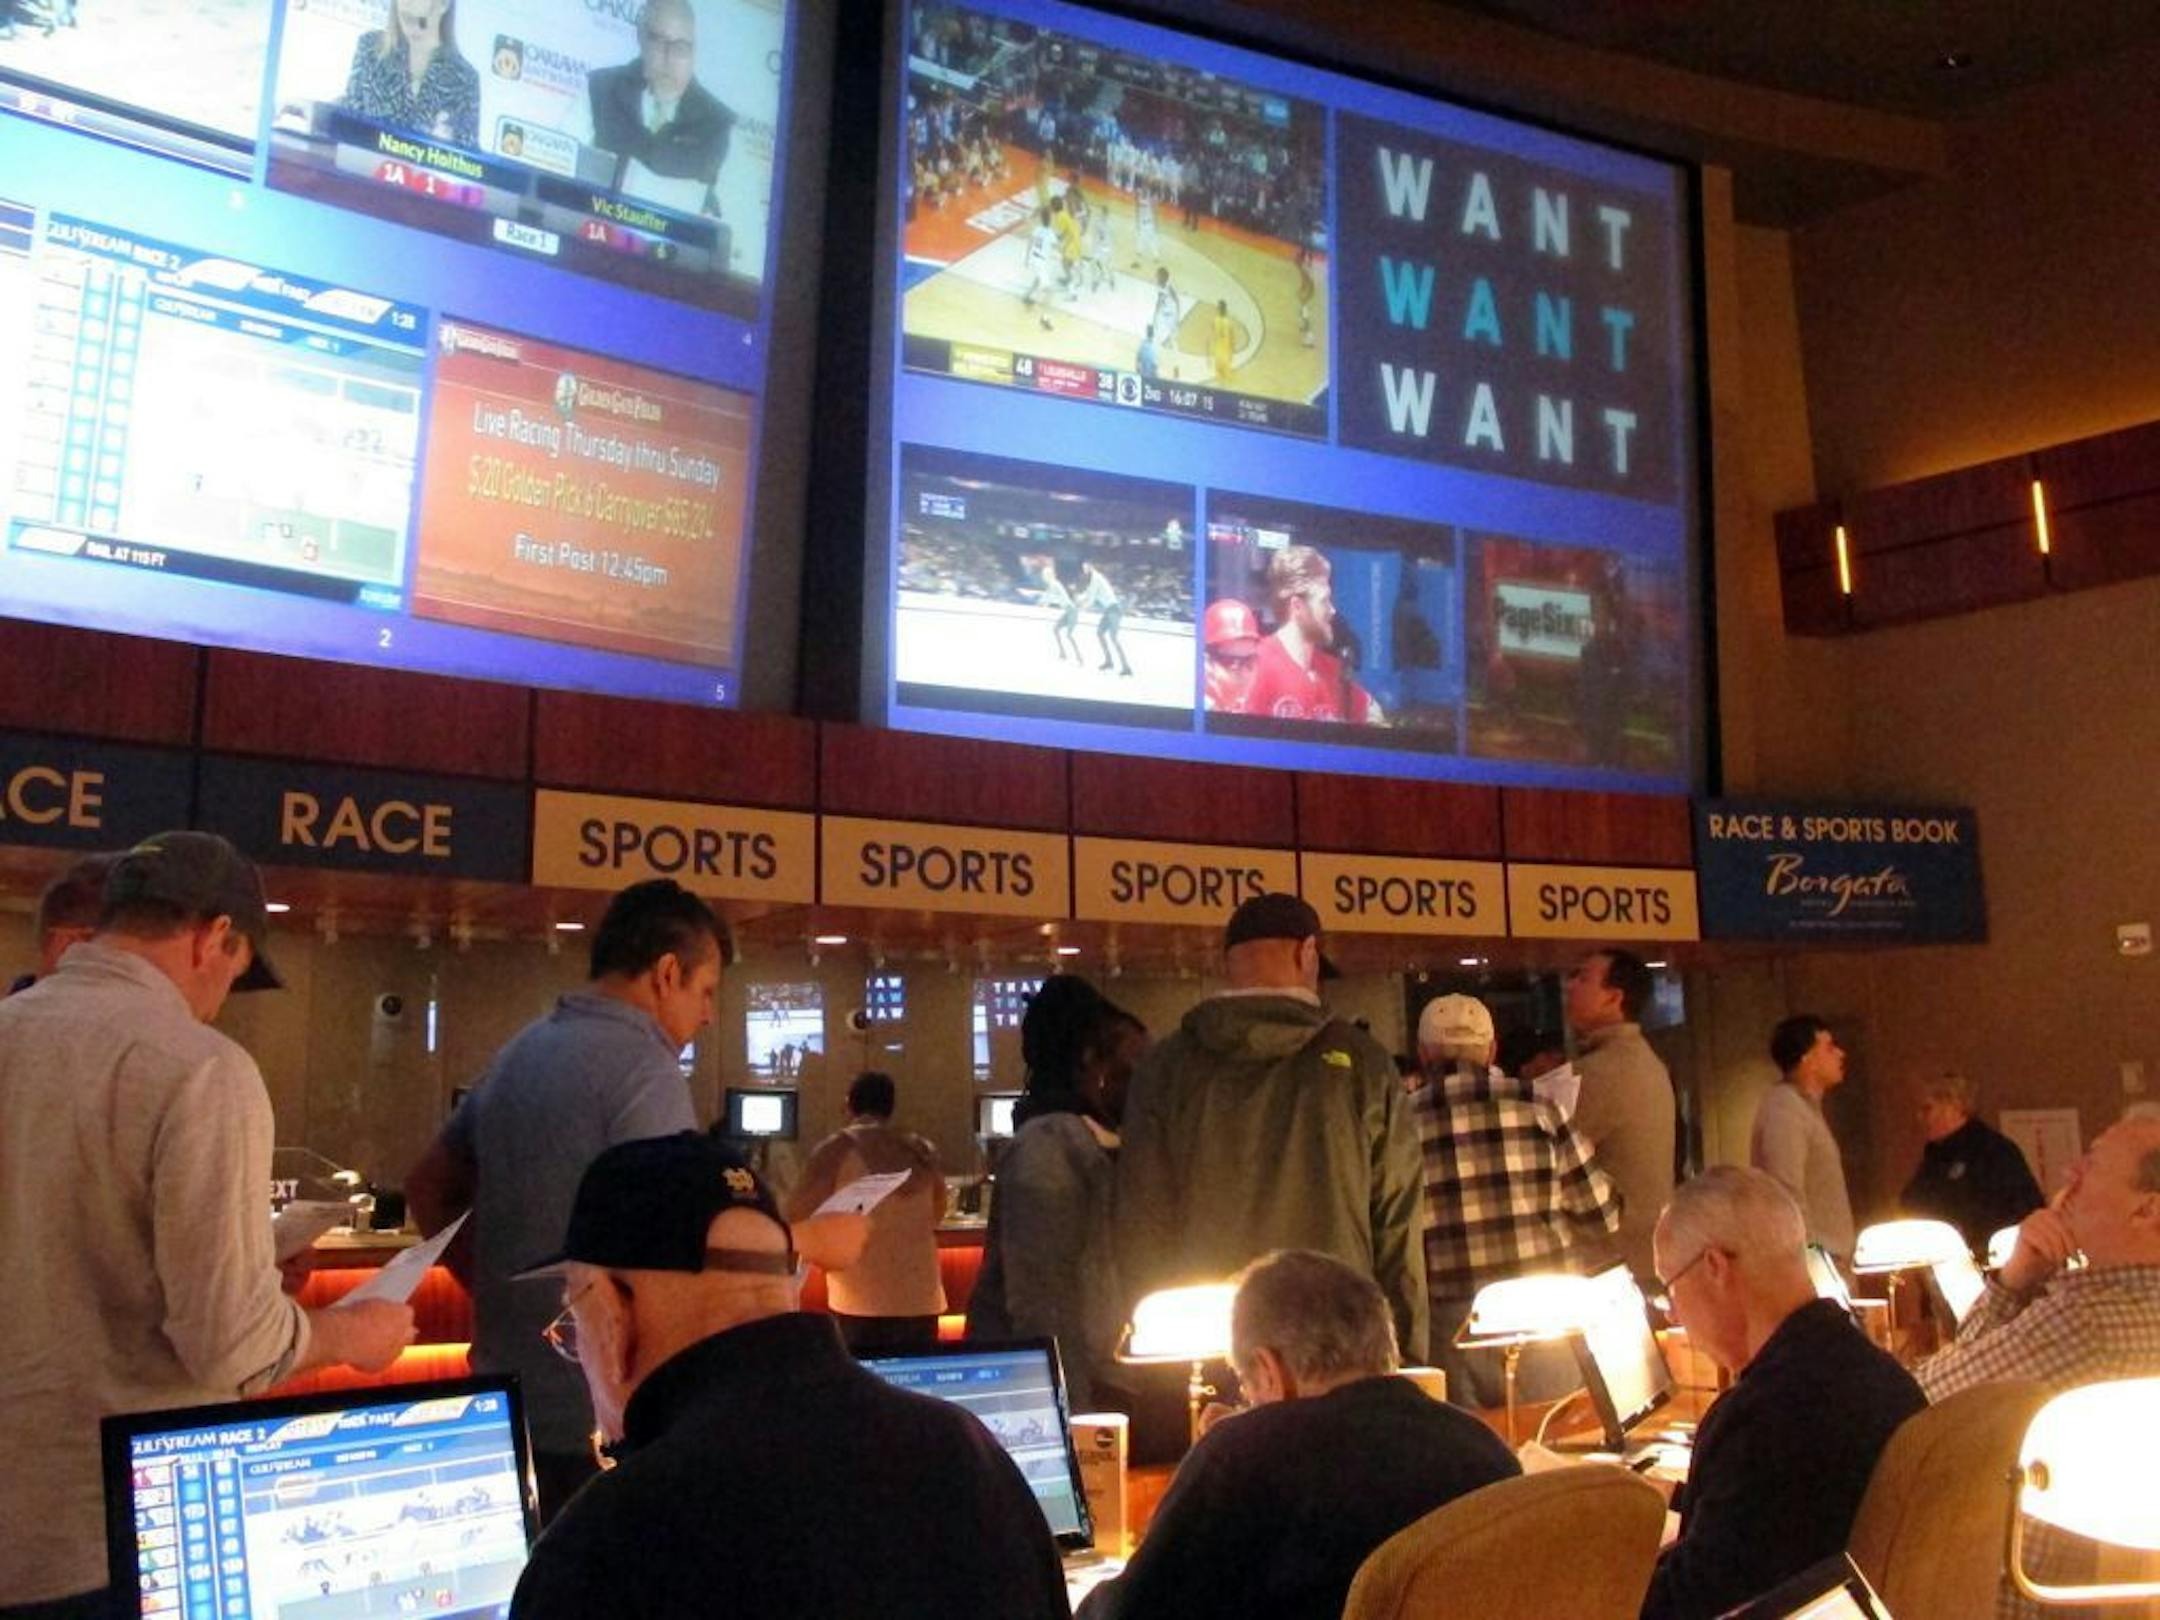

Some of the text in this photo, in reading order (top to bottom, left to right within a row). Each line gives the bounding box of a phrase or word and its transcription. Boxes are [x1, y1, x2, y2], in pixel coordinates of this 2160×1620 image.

[379, 132, 425, 163] Nancy
[427, 141, 483, 179] Holthus
[616, 202, 670, 232] Stauffer
[1378, 147, 1631, 270] WANT
[1380, 256, 1634, 371] WANT
[1380, 362, 1637, 474] WANT
[473, 402, 721, 492] Live Racing Thursday thru Sunday
[514, 532, 669, 590] First Post 12:45pm
[378, 629, 393, 648] 2
[715, 684, 725, 701] 5
[0, 765, 105, 829] CE
[280, 791, 453, 857] RACE
[578, 818, 777, 880] SPORTS
[1709, 814, 1960, 844] RACE & SPORTS BOOK
[860, 841, 1035, 897] SPORTS
[1111, 861, 1267, 907] SPORTS
[1334, 874, 1477, 918] SPORTS
[1764, 852, 1911, 917] Borgata
[1539, 882, 1671, 926] SPORTS
